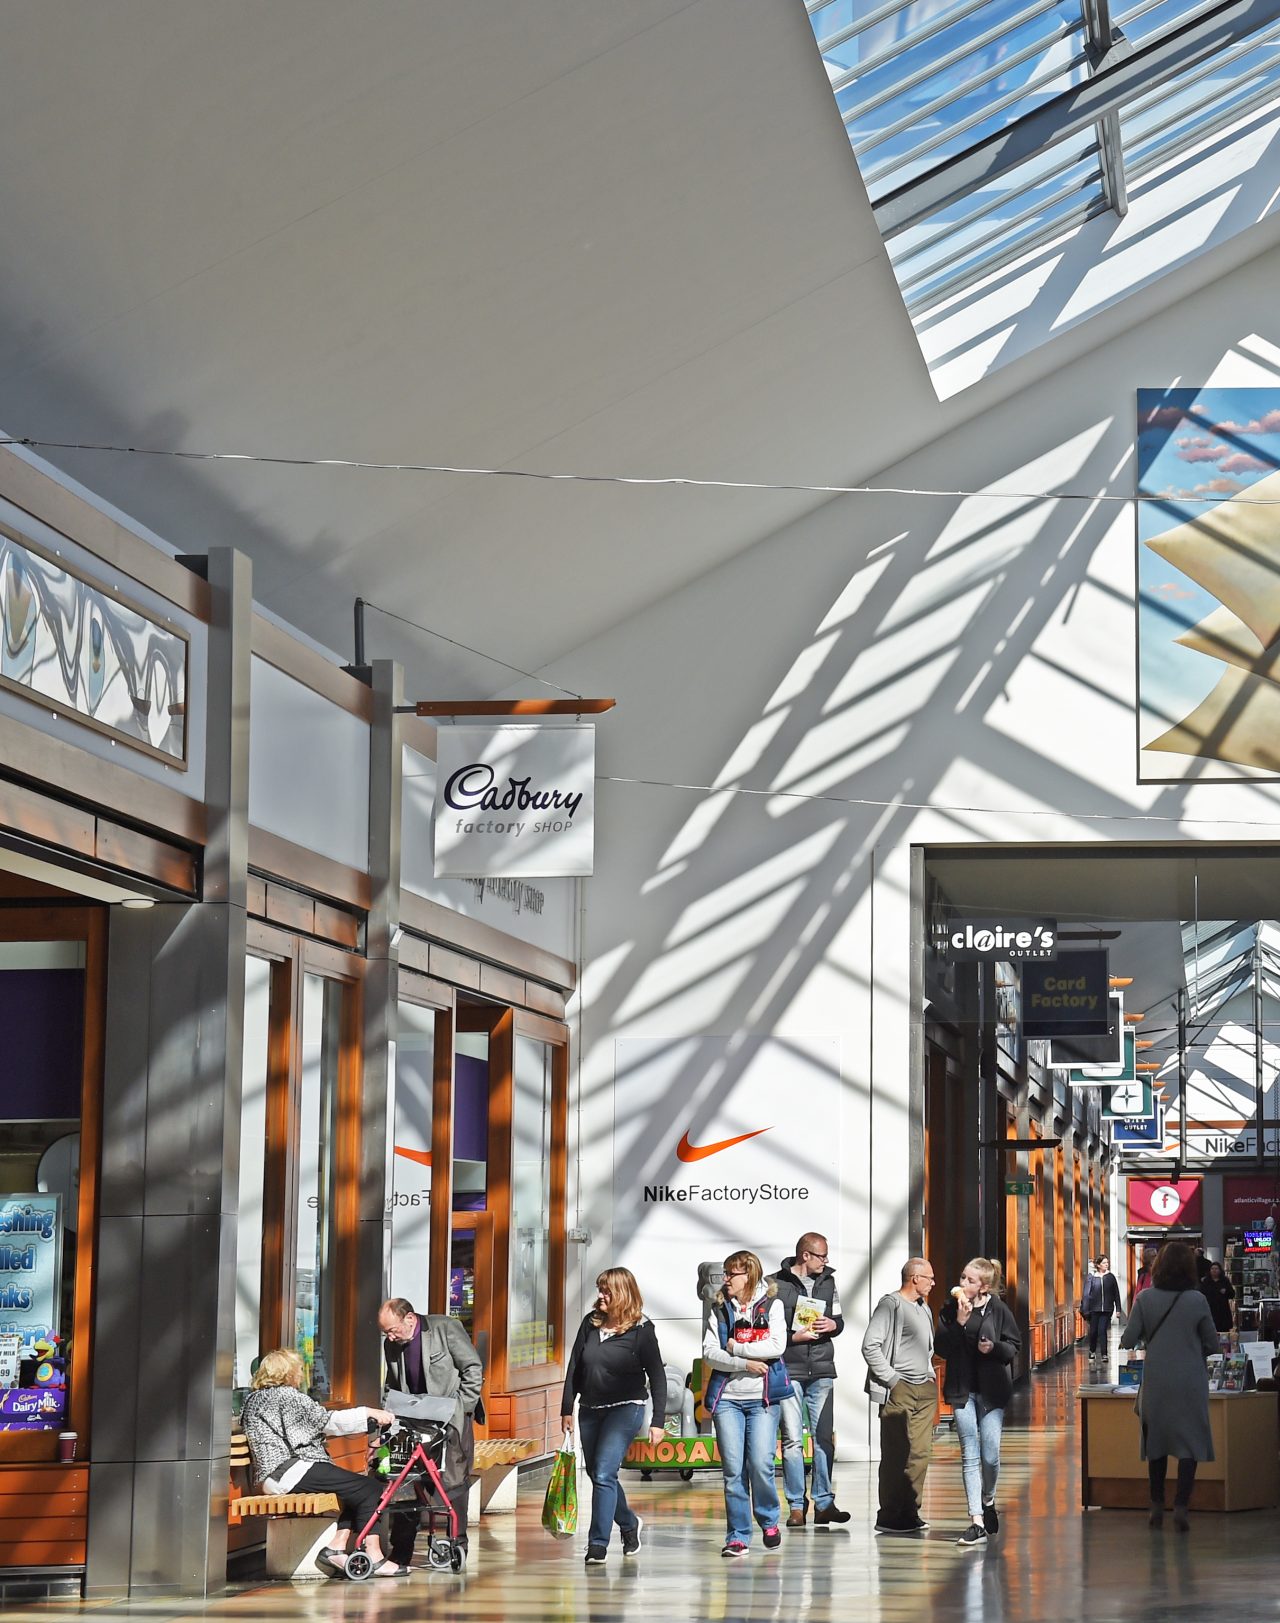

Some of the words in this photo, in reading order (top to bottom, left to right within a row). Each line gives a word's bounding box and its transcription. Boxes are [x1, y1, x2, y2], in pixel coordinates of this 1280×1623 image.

[444, 763, 583, 819] Cadbury
[456, 819, 526, 838] factory
[533, 821, 573, 833] SHOP
[951, 925, 1054, 951] claire's
[1043, 977, 1087, 991] Card
[1031, 993, 1099, 1010] Factory
[644, 1184, 810, 1205] NikeFactoryStore
[0, 1208, 53, 1238] shing
[0, 1247, 34, 1270] lled
[0, 1369, 11, 1377] 99
[12, 1402, 38, 1412] Dairy
[37, 1397, 57, 1408] Milk
